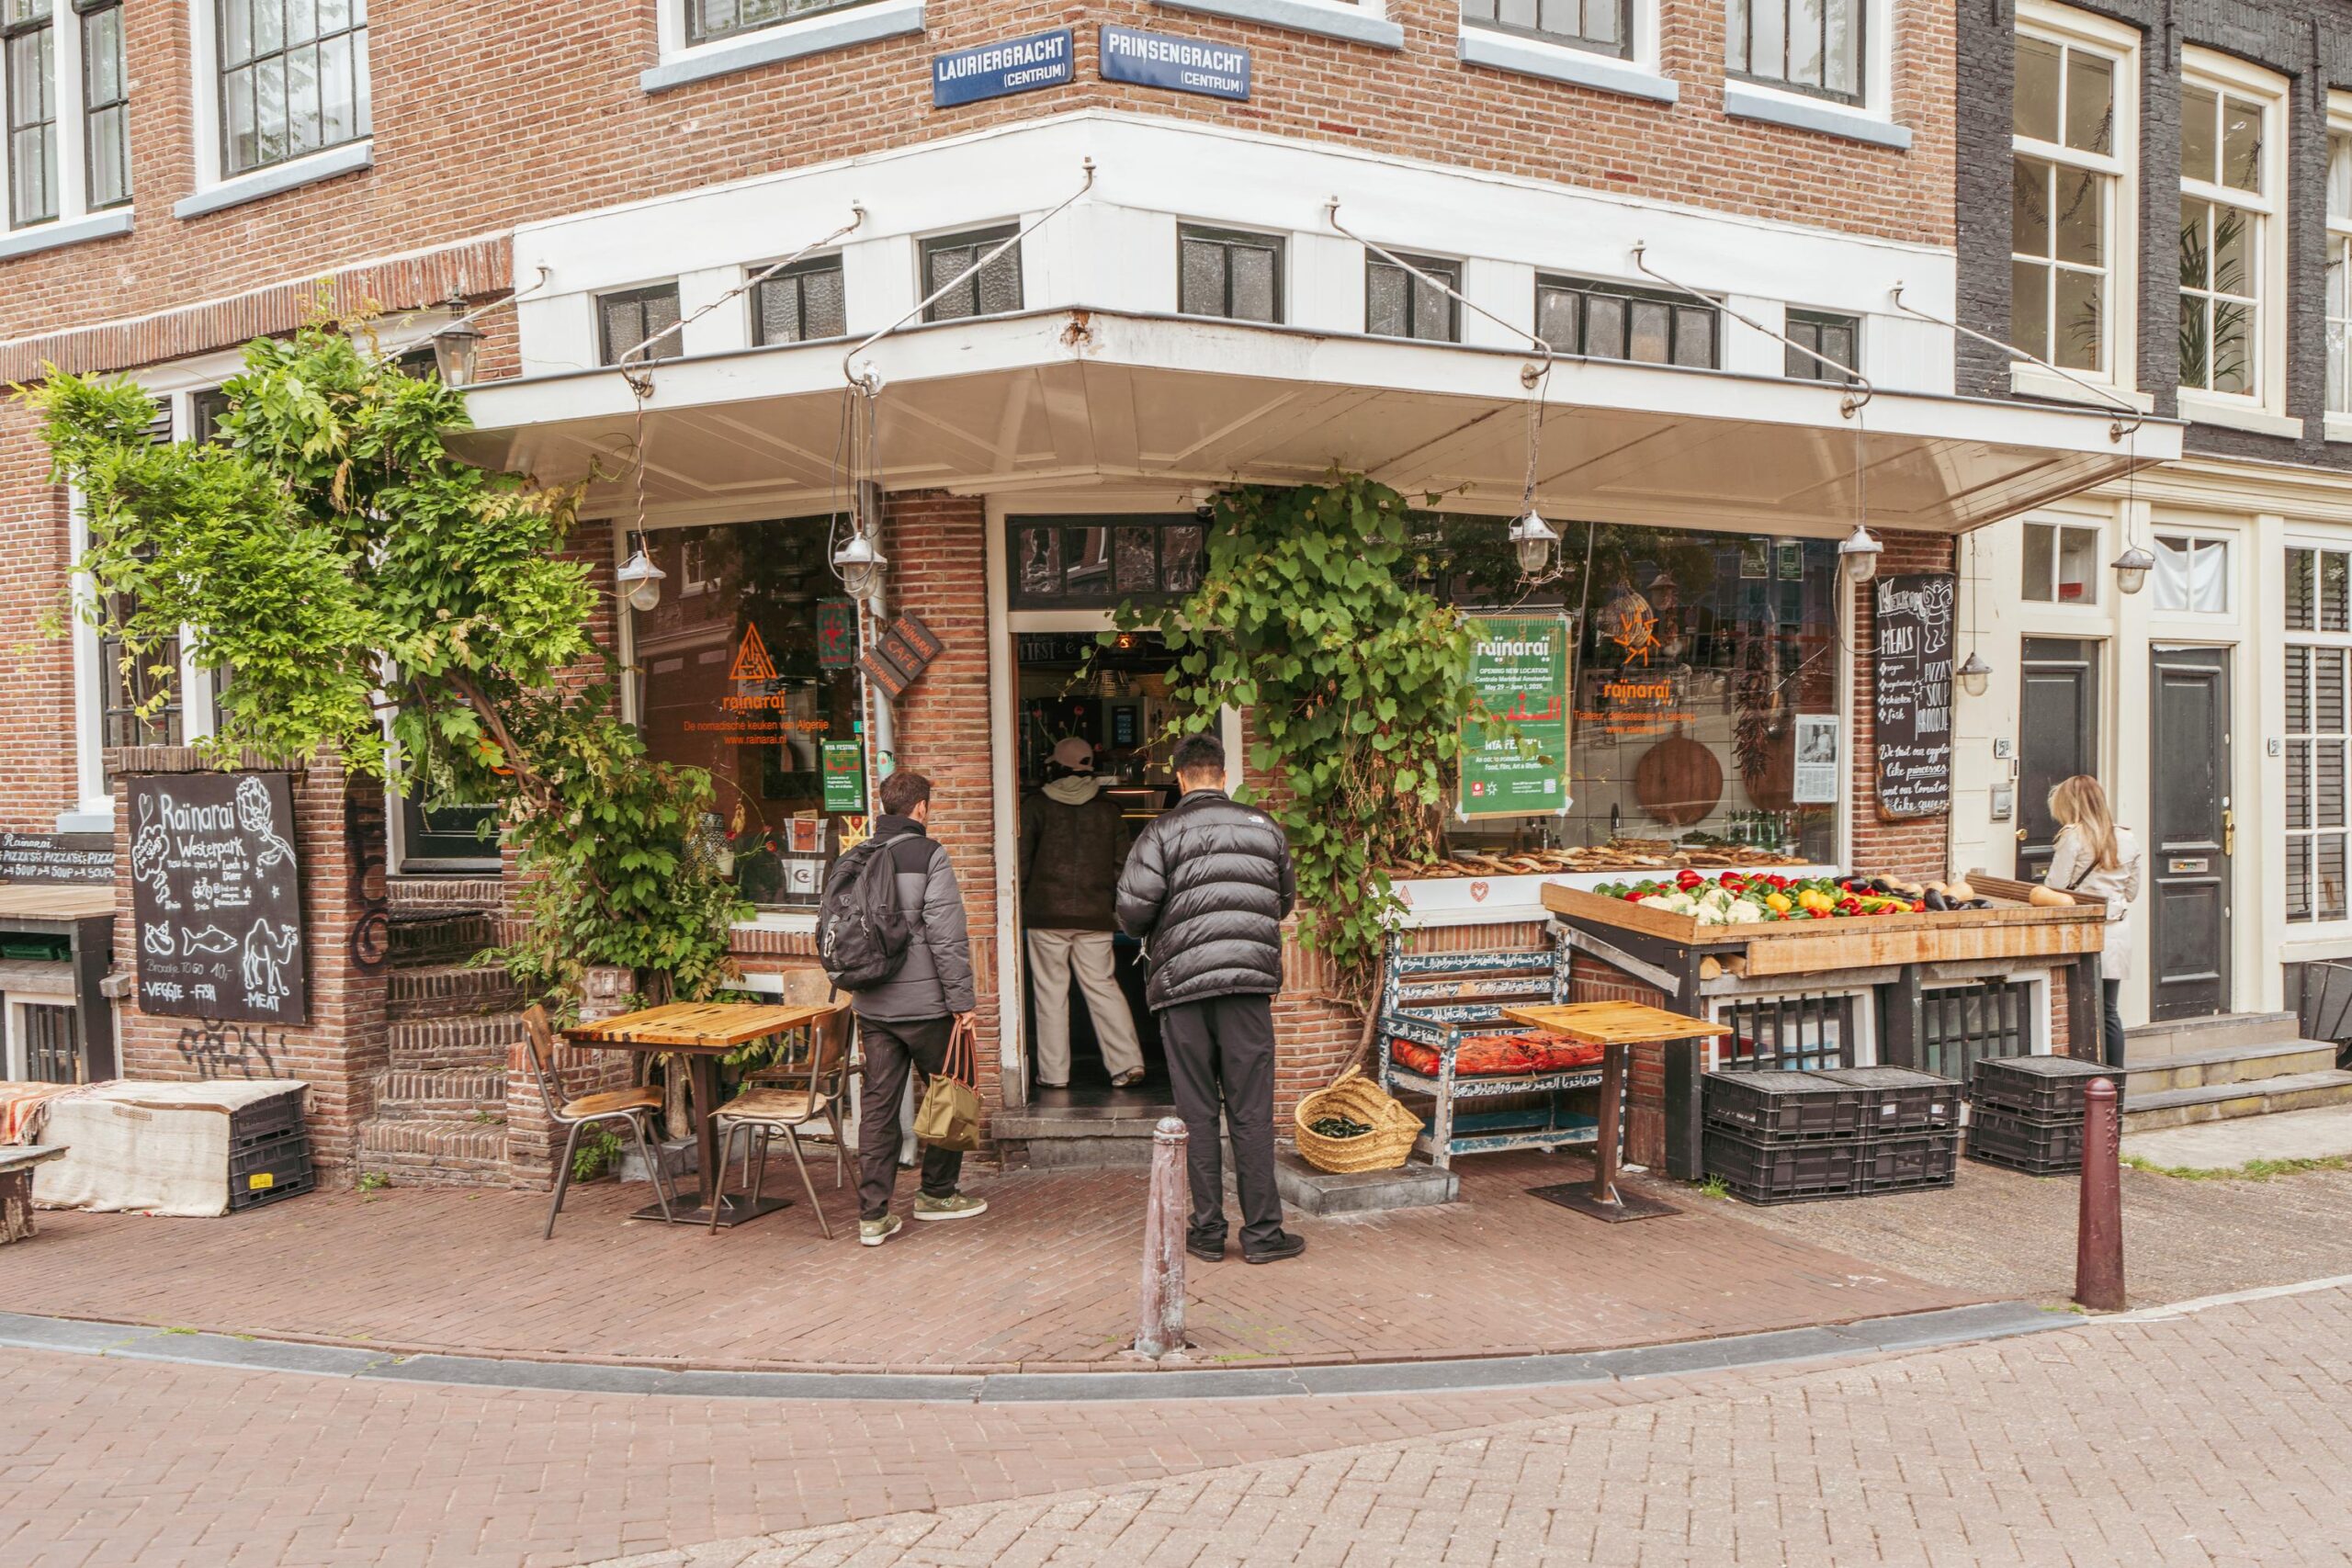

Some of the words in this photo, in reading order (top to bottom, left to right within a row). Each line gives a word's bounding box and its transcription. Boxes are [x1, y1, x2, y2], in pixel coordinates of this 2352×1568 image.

[938, 36, 1065, 82] LAURIERGRACHT
[1108, 33, 1244, 74] PRINSENGRACHT
[1003, 62, 1066, 88] (CENTRUM)
[1181, 70, 1244, 94] (CENTRUM)
[1881, 626, 1914, 655] MEALS
[1926, 682, 1951, 706] SOUP
[684, 721, 695, 731] De
[696, 720, 745, 730] nomadische
[747, 720, 778, 730] keuken
[780, 721, 795, 730] van
[797, 719, 830, 733] Algerije
[1885, 708, 1905, 725] fish
[1886, 761, 1905, 777] like
[160, 794, 235, 832] Raïnaraï
[1893, 796, 1916, 811] like
[3, 850, 37, 863] PIZZA'S
[43, 851, 79, 863] PIZZA'S
[175, 834, 247, 862] Westerpark
[16, 863, 37, 876] SOUP
[51, 865, 74, 878] SOUP
[87, 867, 111, 879] SOUP
[145, 958, 179, 977] Broodje
